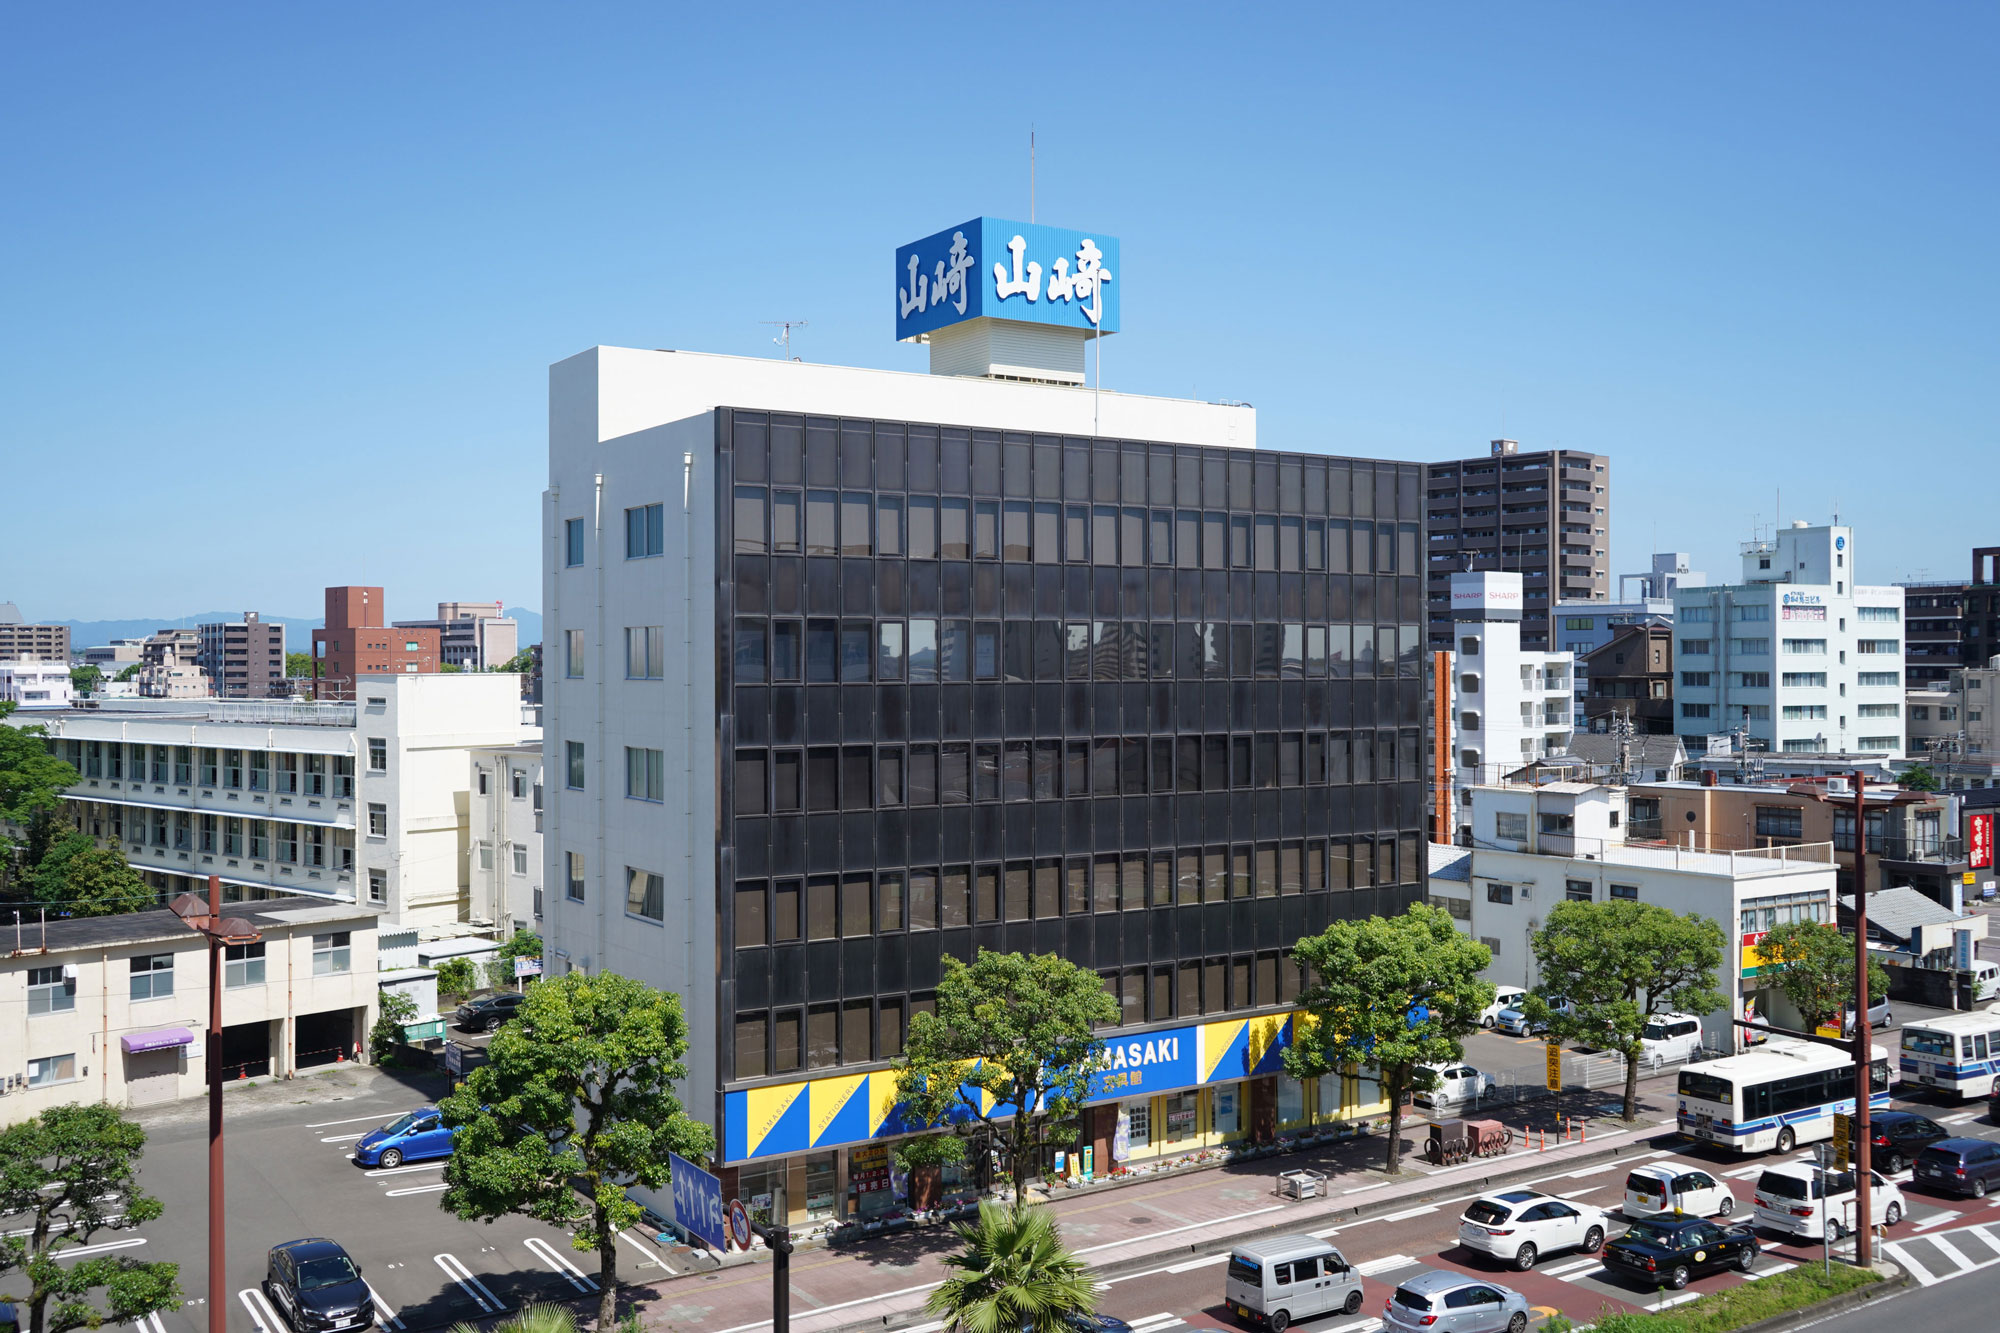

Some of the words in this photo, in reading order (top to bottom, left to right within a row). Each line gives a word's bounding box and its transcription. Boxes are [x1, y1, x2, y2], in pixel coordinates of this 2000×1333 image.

[1453, 592, 1482, 600] SHARP
[1488, 591, 1519, 600] SHARP
[1078, 1037, 1179, 1074] MASAKI
[1548, 1047, 1559, 1089] 追突注意
[758, 1093, 794, 1138] YAMASAKI
[817, 1084, 856, 1131] STATIONERY
